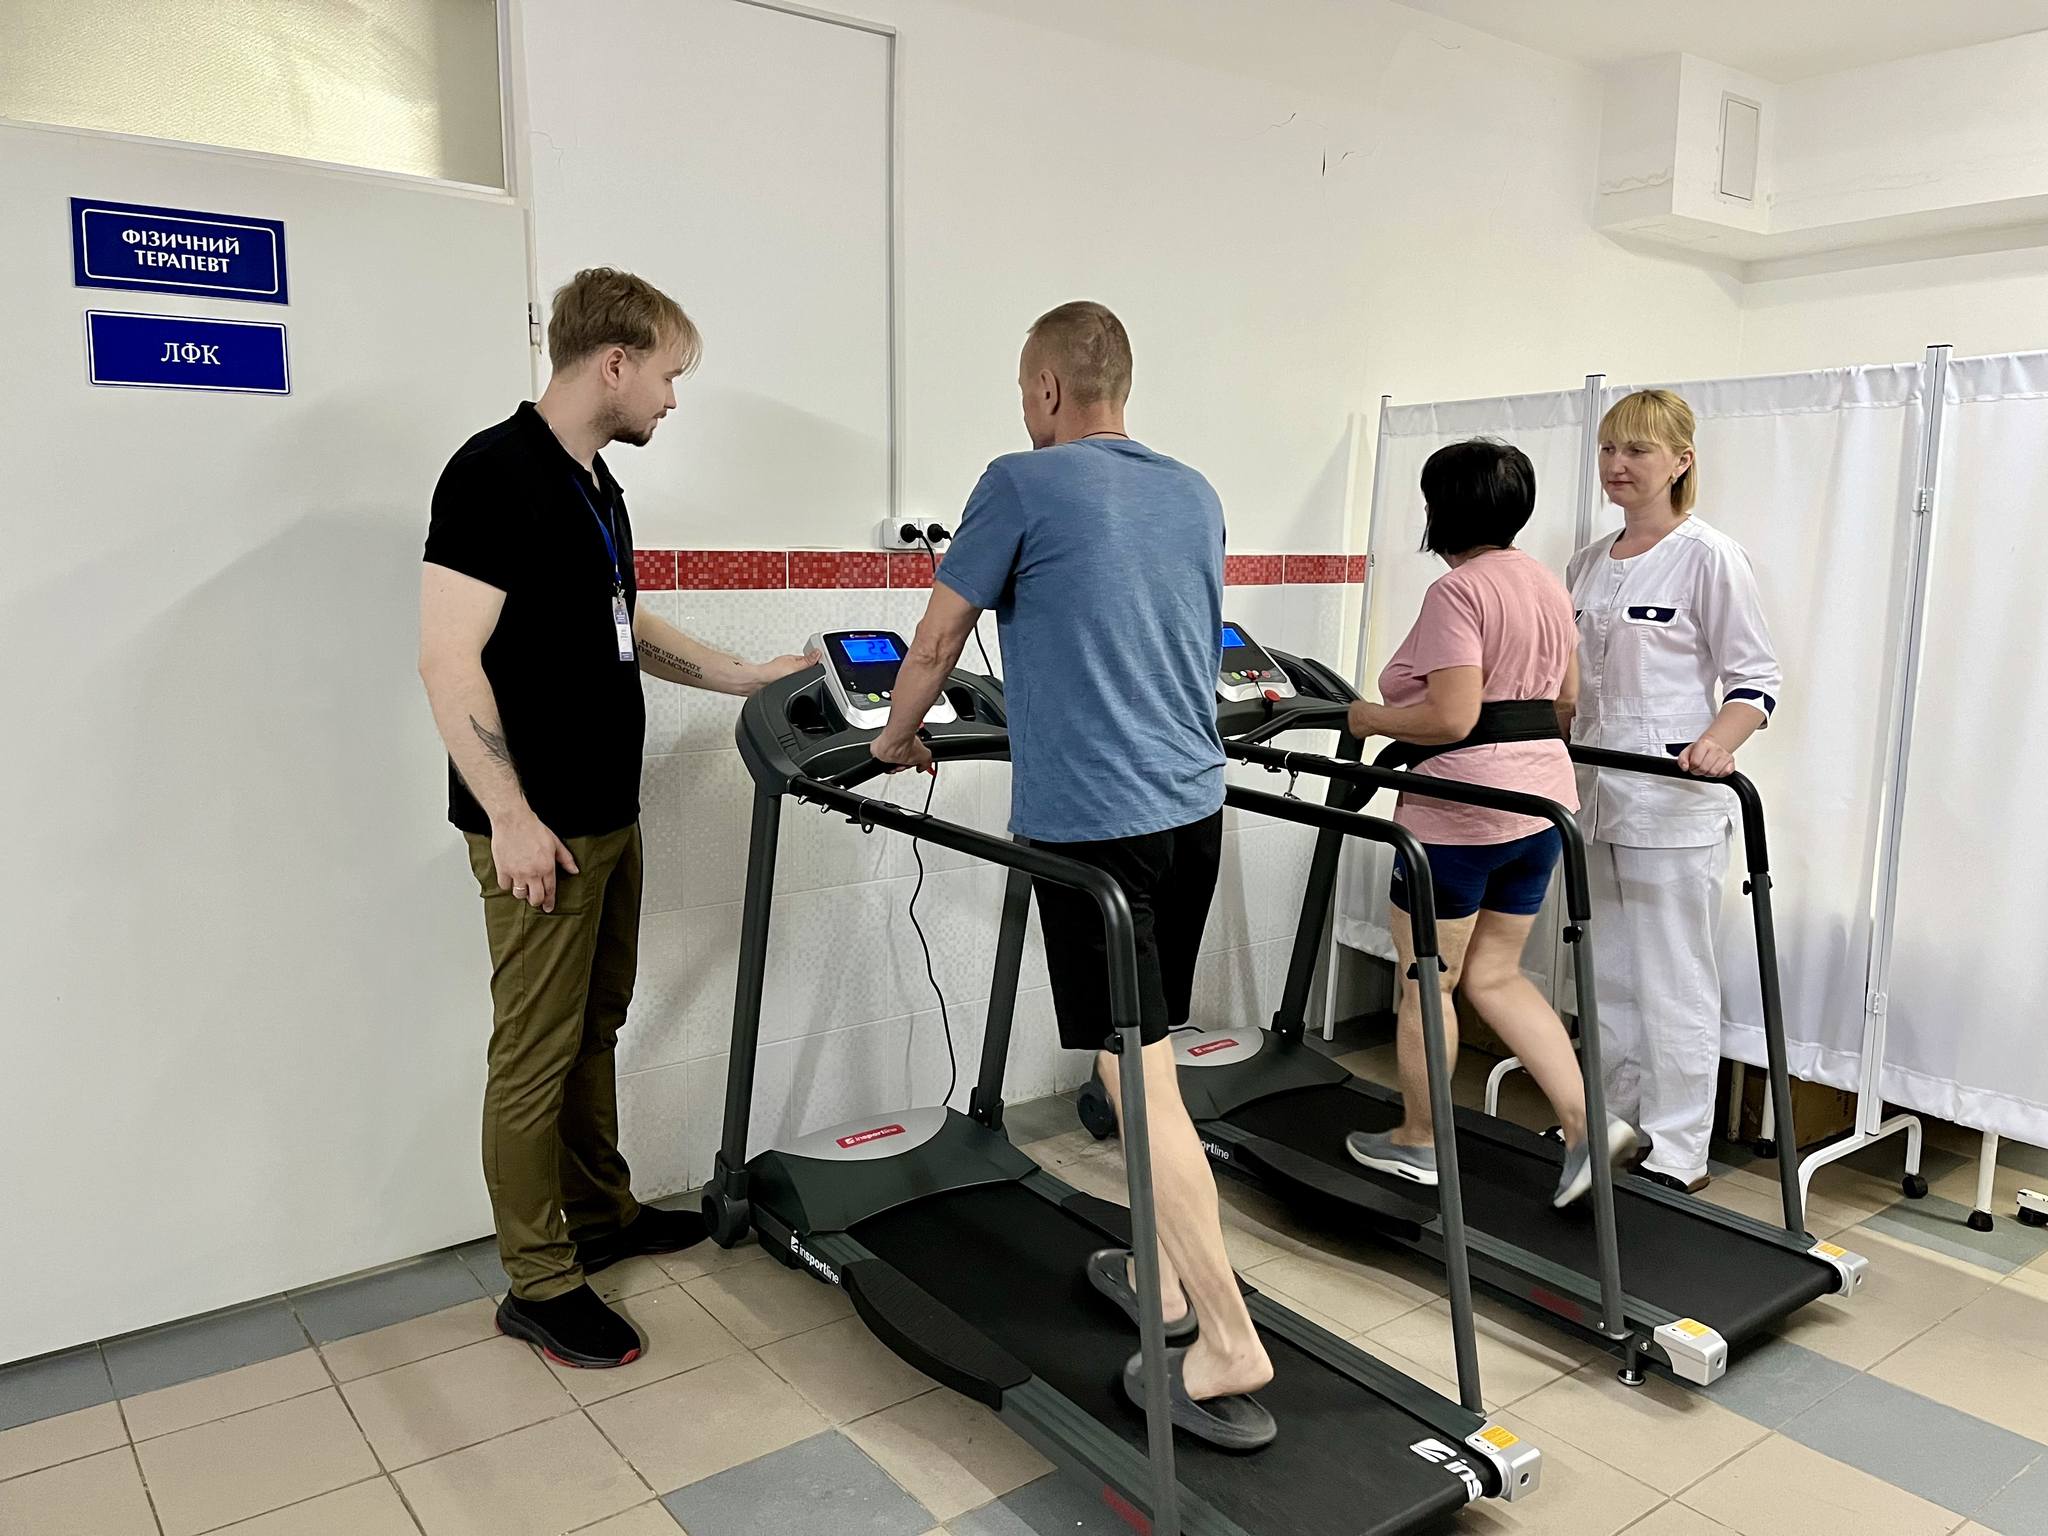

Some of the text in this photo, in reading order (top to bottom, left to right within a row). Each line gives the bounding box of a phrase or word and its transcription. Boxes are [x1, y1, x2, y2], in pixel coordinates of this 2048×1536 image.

[122, 229, 240, 255] ФІЗИЧНИЙ
[133, 249, 230, 273] ТЕРАПЕВТ
[160, 342, 221, 365] ЛФК
[1199, 1140, 1230, 1160] ortline
[799, 1243, 840, 1284] insportline
